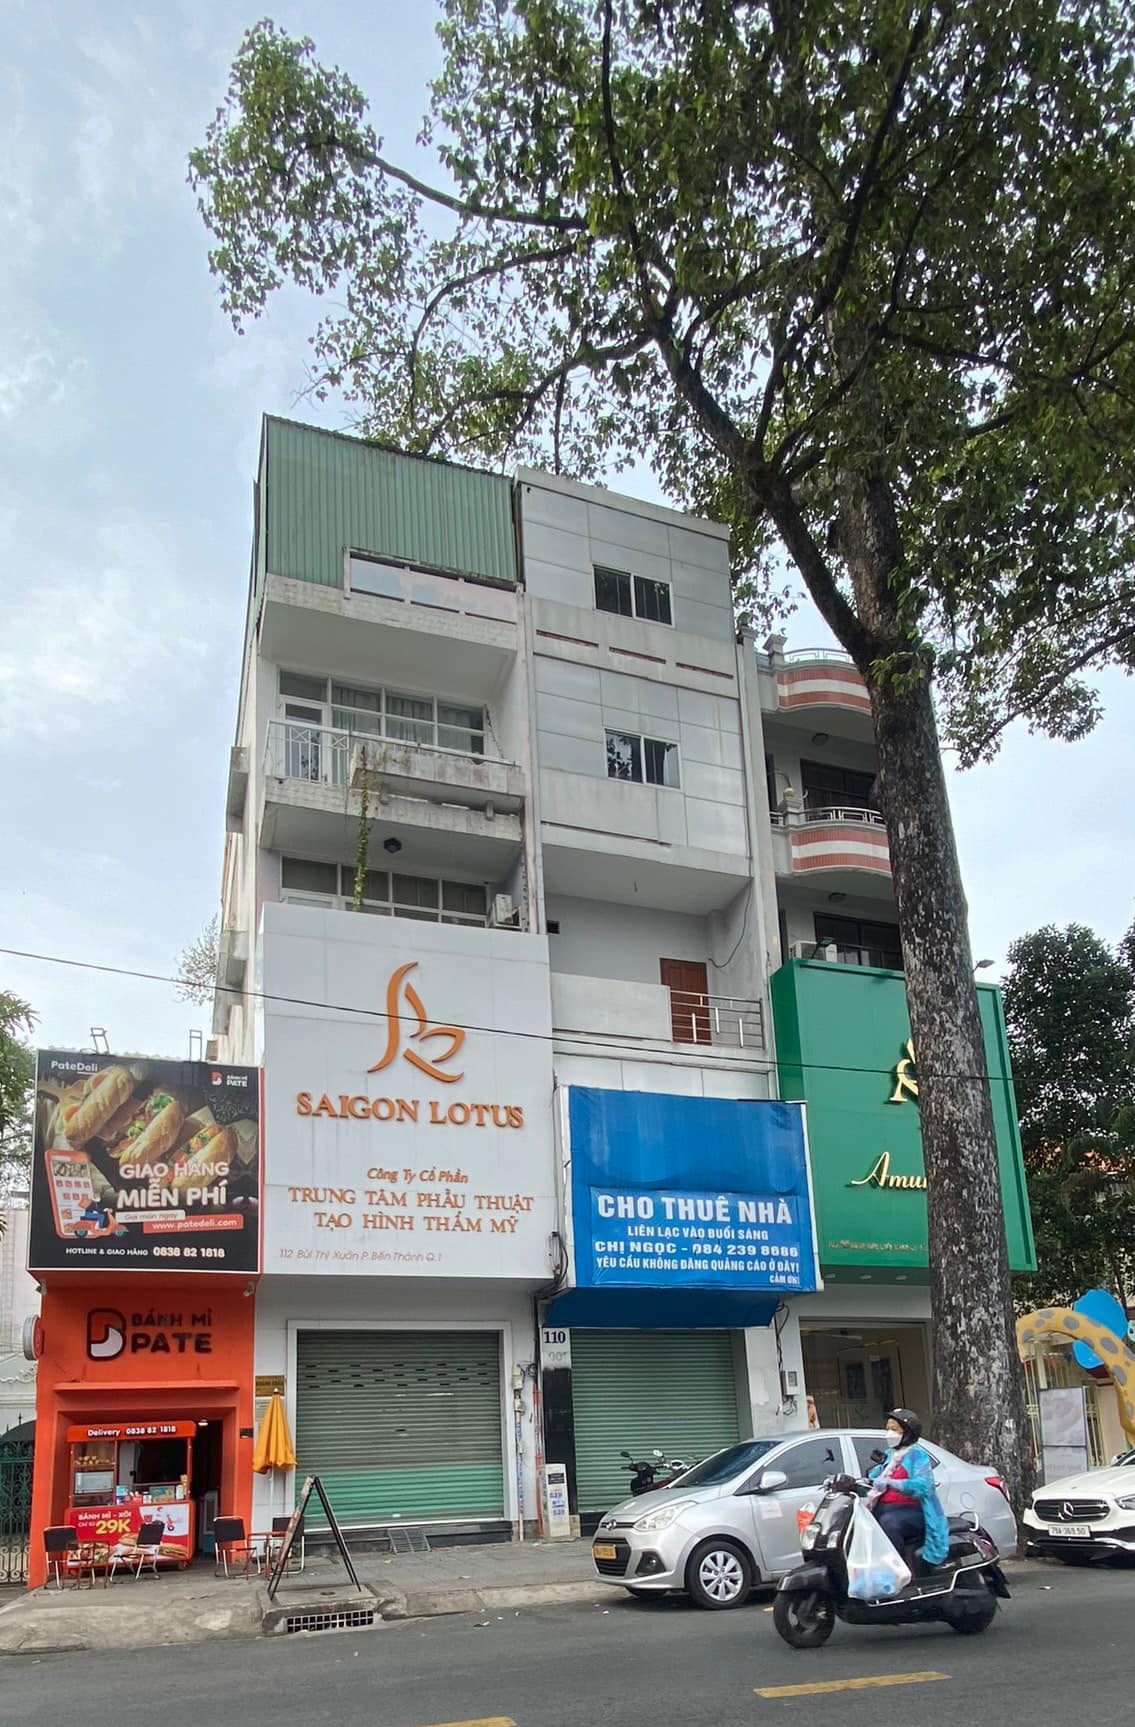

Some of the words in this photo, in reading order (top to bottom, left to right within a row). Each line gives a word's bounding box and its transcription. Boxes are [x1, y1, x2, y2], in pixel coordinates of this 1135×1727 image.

[51, 1061, 98, 1072] PateDeli
[226, 1080, 248, 1088] PATE
[296, 1092, 420, 1122] SAIGON
[429, 1101, 525, 1129] LOTUS
[119, 1162, 169, 1179] GIAO
[367, 1168, 399, 1184] Công
[403, 1168, 417, 1184] Ty
[117, 1178, 179, 1209] MIỄN
[186, 1180, 228, 1206] PHÍ
[288, 1187, 356, 1204] TRUNG
[364, 1189, 408, 1207] TÂM
[416, 1188, 466, 1209] PHẪU
[474, 1194, 534, 1214] THUẬT
[597, 1194, 655, 1219] CHO
[661, 1196, 731, 1222] THUÊ
[738, 1198, 793, 1225] NHÀ
[314, 1212, 353, 1231] TẠO
[362, 1211, 415, 1231] HÌNH
[423, 1211, 482, 1232] THẨM
[491, 1215, 519, 1233] MỸ
[627, 1224, 655, 1238] LIÊN
[657, 1226, 680, 1240] LẠC
[682, 1226, 705, 1239] VÀO
[738, 1227, 769, 1241] SÁNG
[65, 1247, 97, 1256] HOTLINE
[106, 1248, 127, 1257] GIAO
[183, 1247, 198, 1258] 82
[200, 1247, 226, 1259] 1818
[594, 1241, 625, 1255] CHỊ
[629, 1242, 677, 1256] NGỌC
[727, 1245, 756, 1256] 239
[597, 1255, 617, 1269] YÊU
[619, 1255, 640, 1269] CẦU
[643, 1257, 678, 1270] KHÔNG
[710, 1257, 745, 1271] QUẢNG
[746, 1258, 767, 1272] CÁO
[131, 1308, 182, 1327] BÁNH
[191, 1308, 212, 1327] MÌ
[131, 1333, 212, 1353] PATE
[543, 1331, 566, 1344] 110
[88, 1429, 121, 1437] Delivery
[78, 1511, 100, 1521] BÁNH
[95, 1518, 131, 1535] 29K
